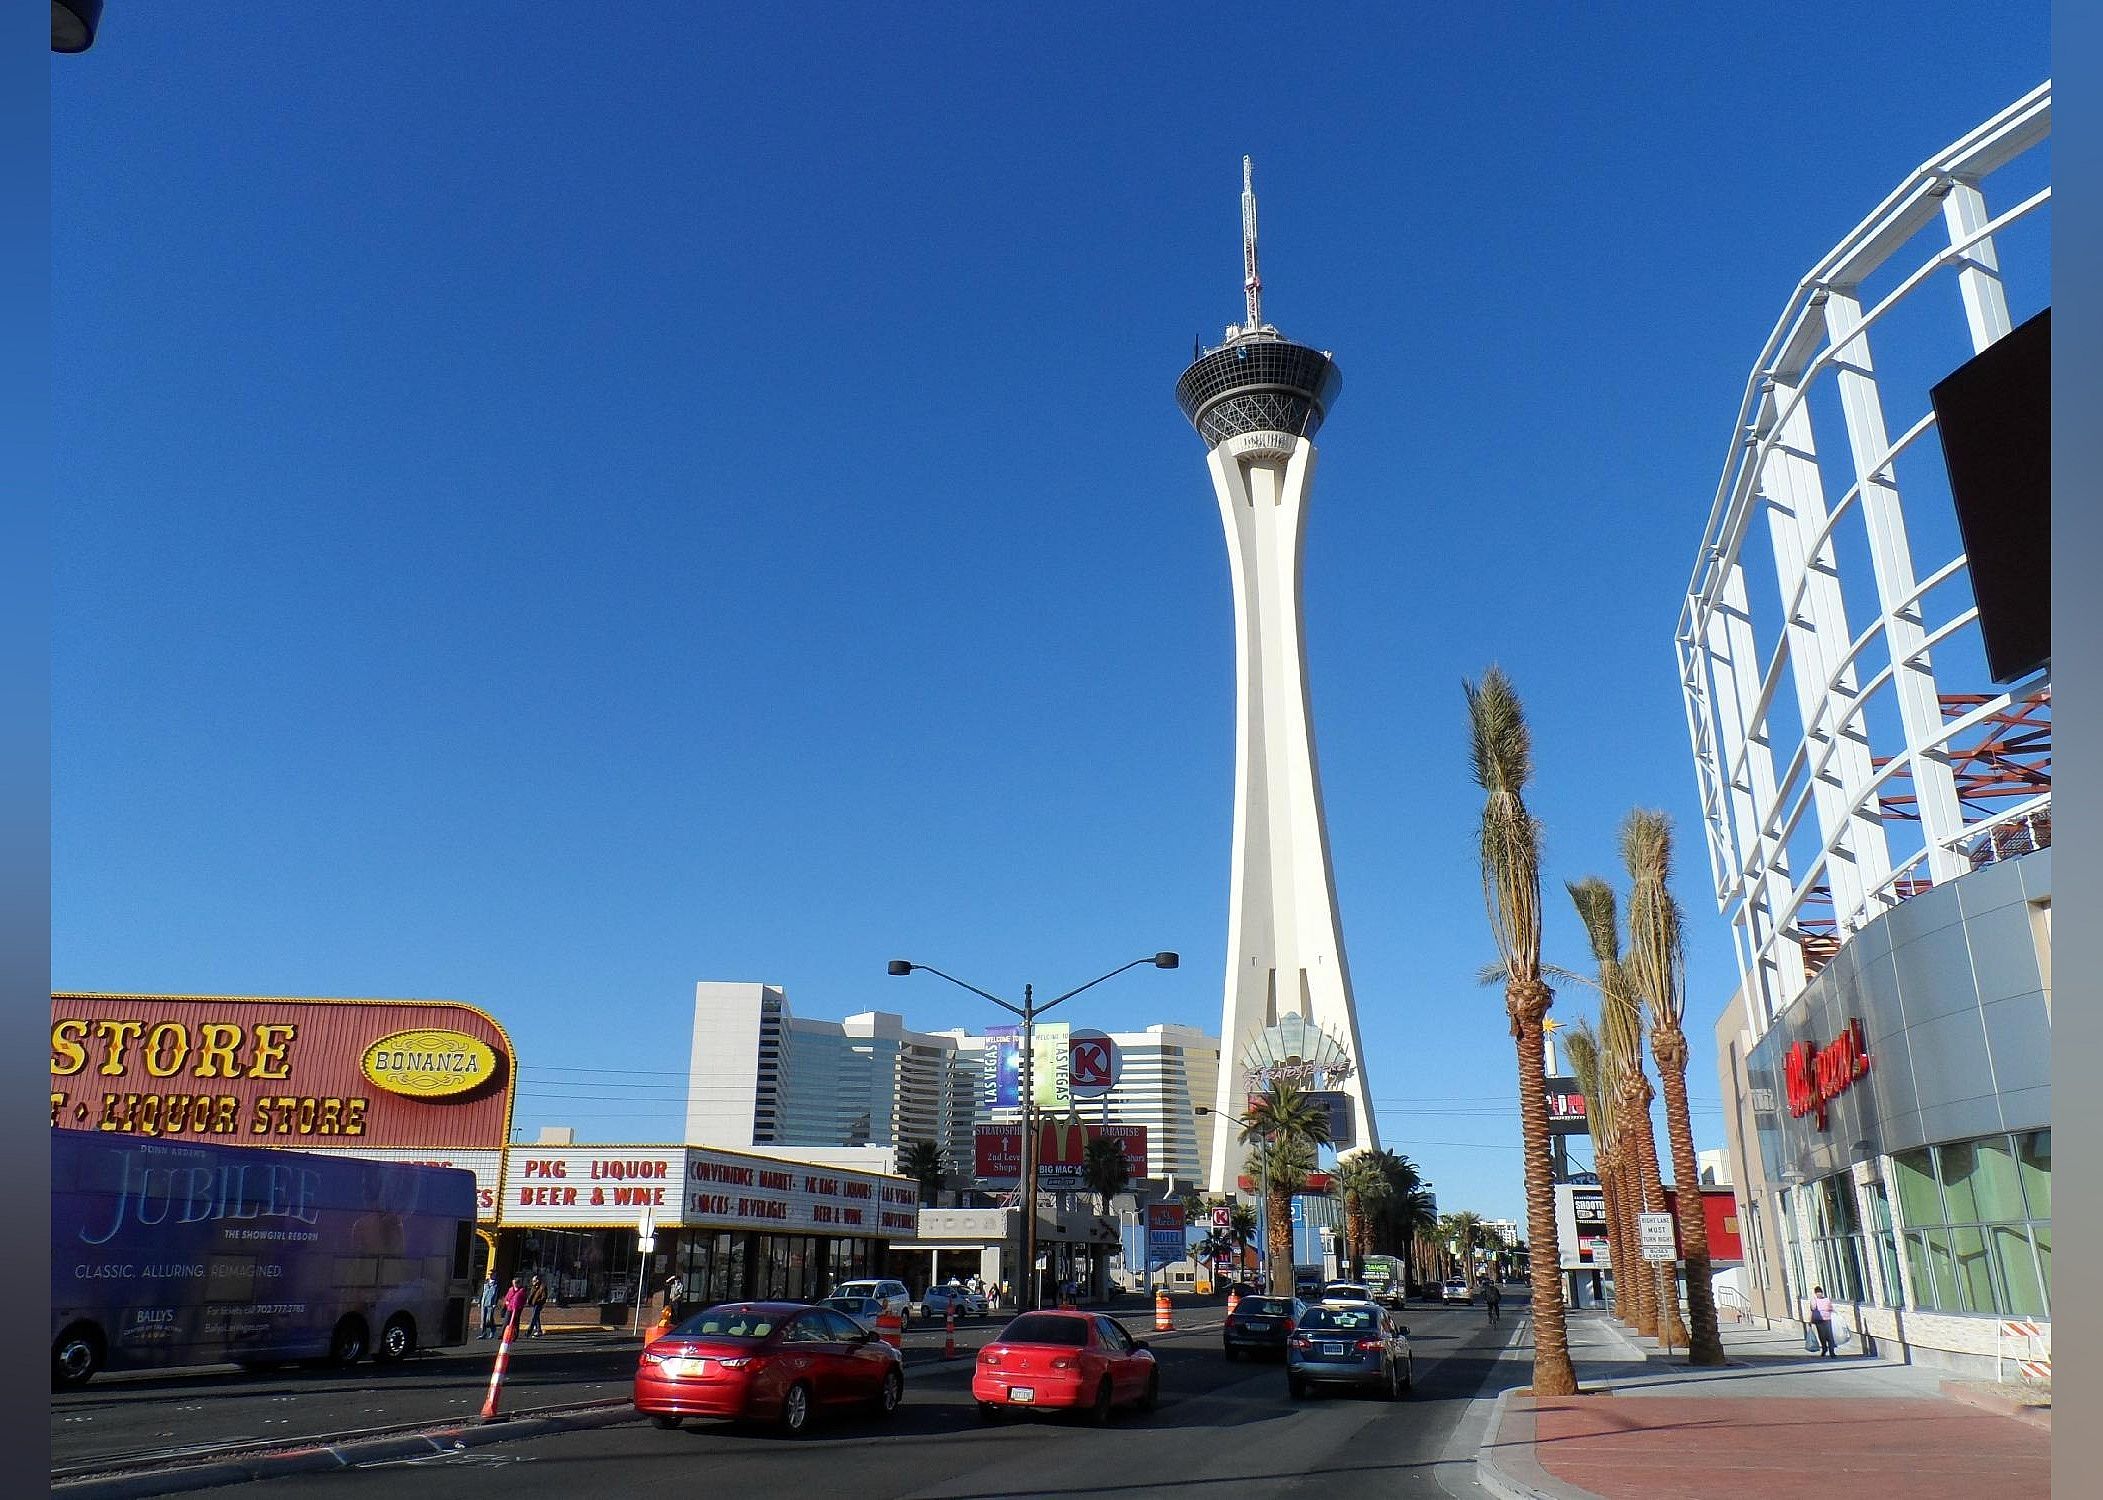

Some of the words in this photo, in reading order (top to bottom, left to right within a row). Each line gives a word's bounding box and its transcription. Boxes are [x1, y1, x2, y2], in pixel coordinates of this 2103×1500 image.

[51, 1020, 298, 1080] STORE
[1056, 1042, 1069, 1062] LAS
[375, 1052, 480, 1073] BONANZA
[984, 1044, 998, 1078] VEGAS
[1075, 1046, 1105, 1079] K
[984, 1079, 998, 1103] LAS
[1056, 1062, 1069, 1101] VEGAS
[99, 1093, 240, 1136] LIQUOR
[251, 1097, 370, 1136] STORE
[1100, 1127, 1140, 1136] PARADISE
[1004, 1152, 1022, 1161] Leve
[524, 1160, 567, 1179] PKG
[590, 1160, 668, 1181] LIQUOR
[1039, 1165, 1054, 1174] BIG
[1055, 1164, 1074, 1174] MAC
[79, 1151, 322, 1245] JUBILEE
[519, 1187, 578, 1206] BEER
[590, 1187, 605, 1206] &
[882, 1186, 894, 1201] LAS
[813, 1204, 832, 1223] BEER
[224, 1230, 240, 1239] THE
[242, 1230, 287, 1241] SHOWGIRL
[288, 1232, 319, 1241] REBORN
